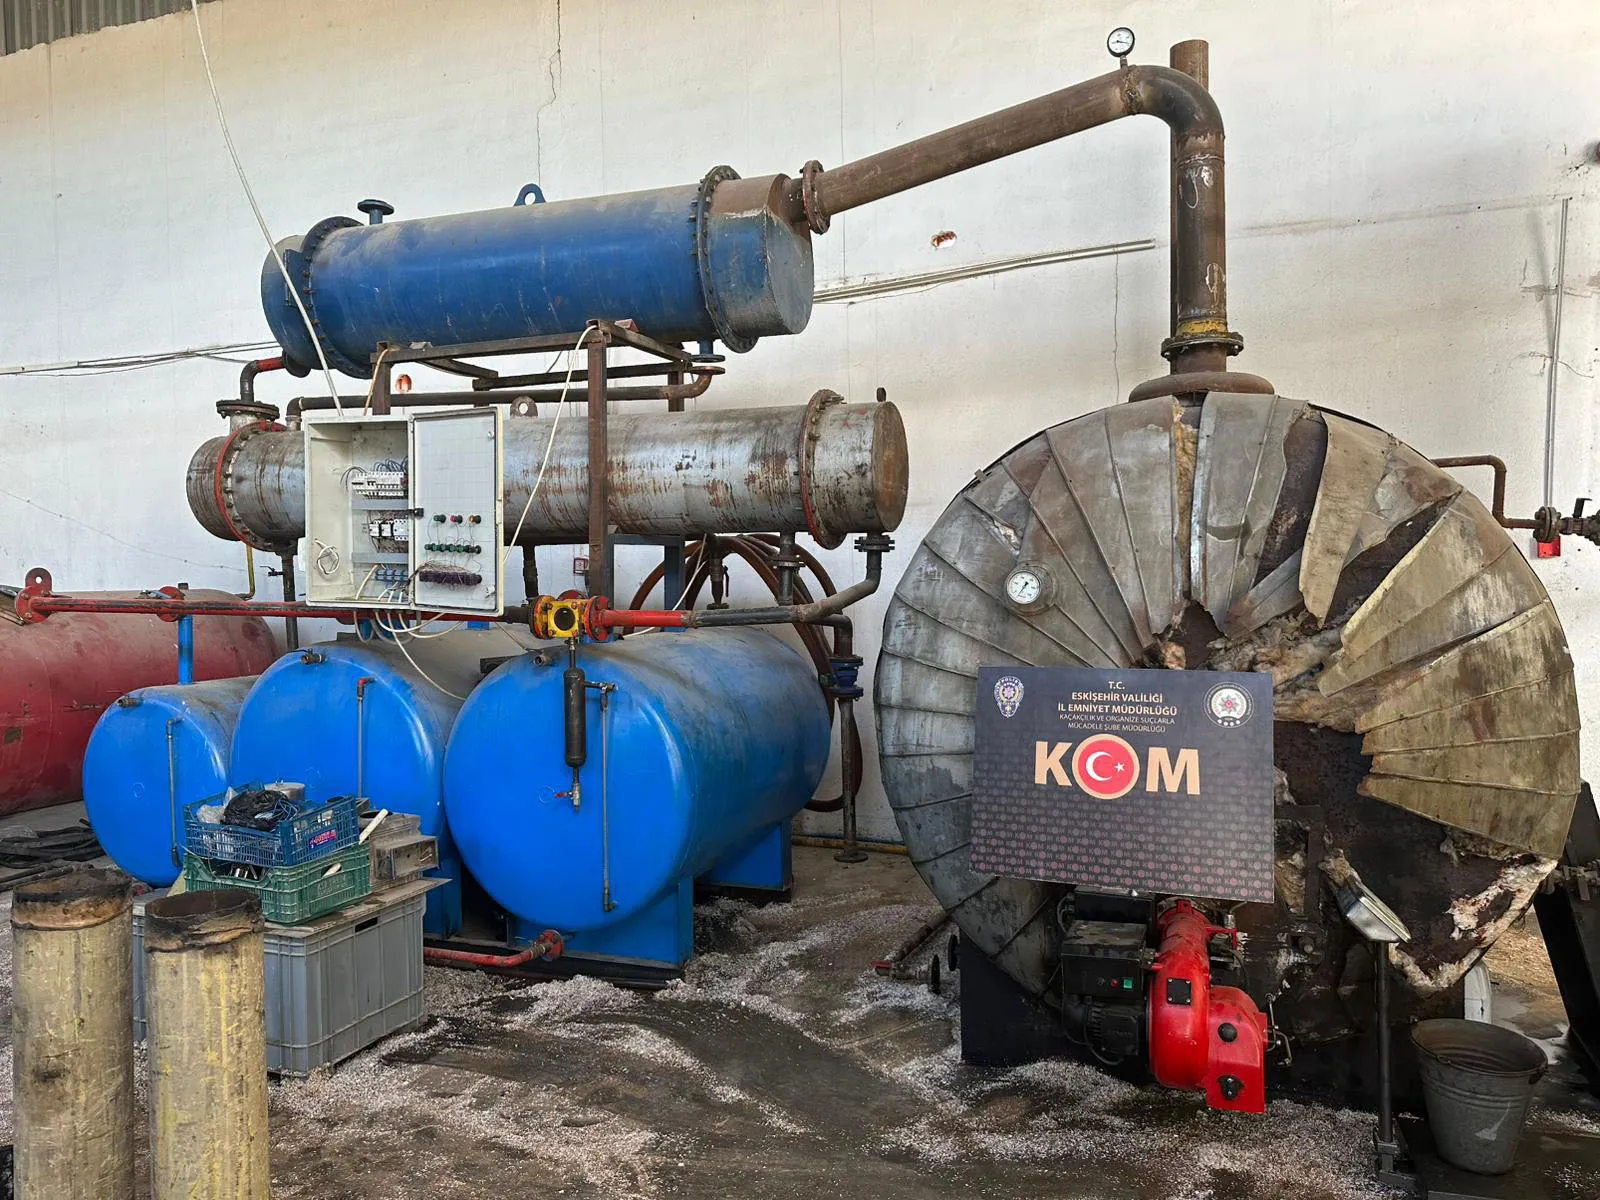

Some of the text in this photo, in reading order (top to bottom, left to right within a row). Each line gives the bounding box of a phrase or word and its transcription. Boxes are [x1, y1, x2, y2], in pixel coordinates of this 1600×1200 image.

[1108, 681, 1125, 690] T.C.
[1071, 690, 1163, 703] ESKİŞEHİR VALİLİĞİ
[1058, 701, 1177, 716] İL EMNİYET MÜDÜRLÜĞÜ
[1034, 733, 1201, 800] KOM
